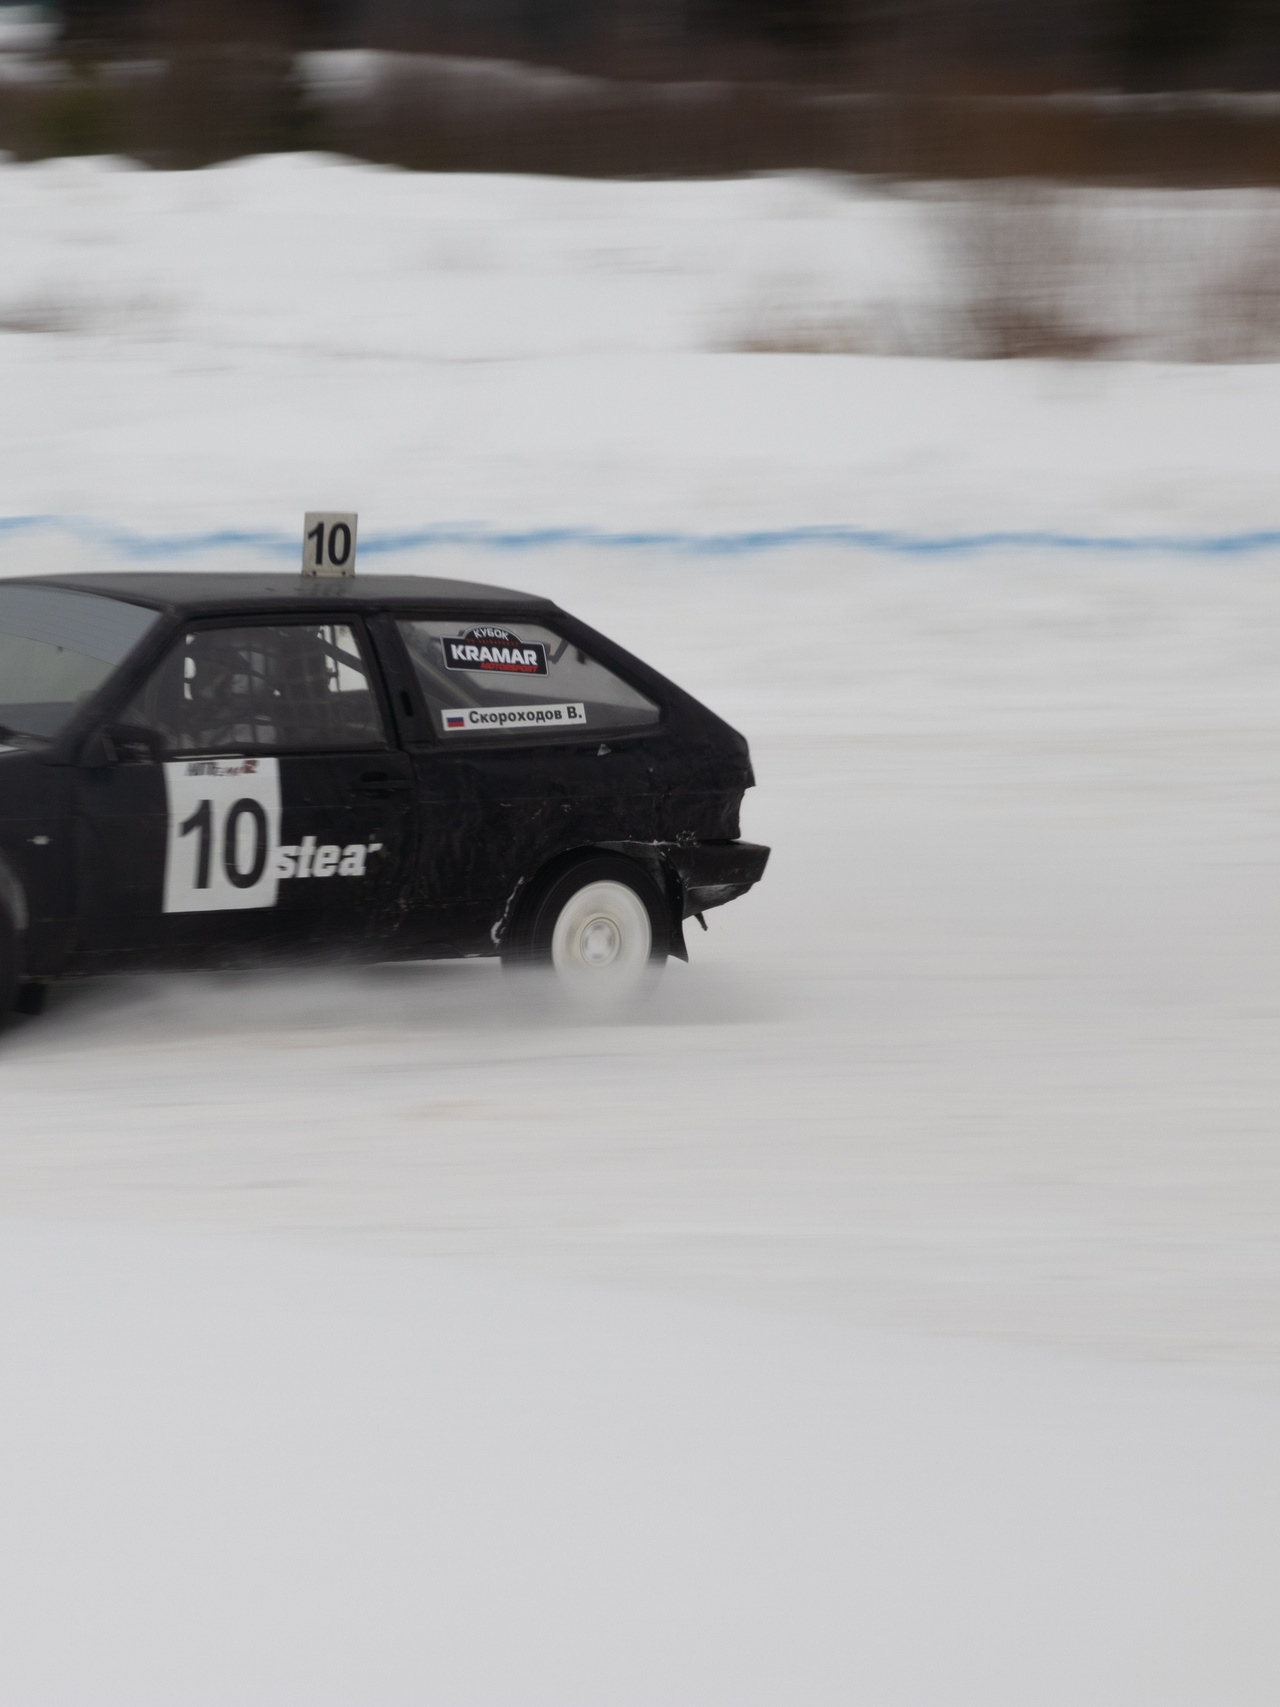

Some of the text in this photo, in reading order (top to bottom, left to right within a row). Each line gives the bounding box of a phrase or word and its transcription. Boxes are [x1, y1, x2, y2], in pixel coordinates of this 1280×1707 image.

[307, 521, 351, 567] 10
[473, 627, 510, 641] КУБОК
[450, 643, 538, 666] KRAMAR
[480, 662, 538, 673] MOTORSPORT
[468, 706, 582, 726] Скороходов В.
[177, 798, 268, 889] 10
